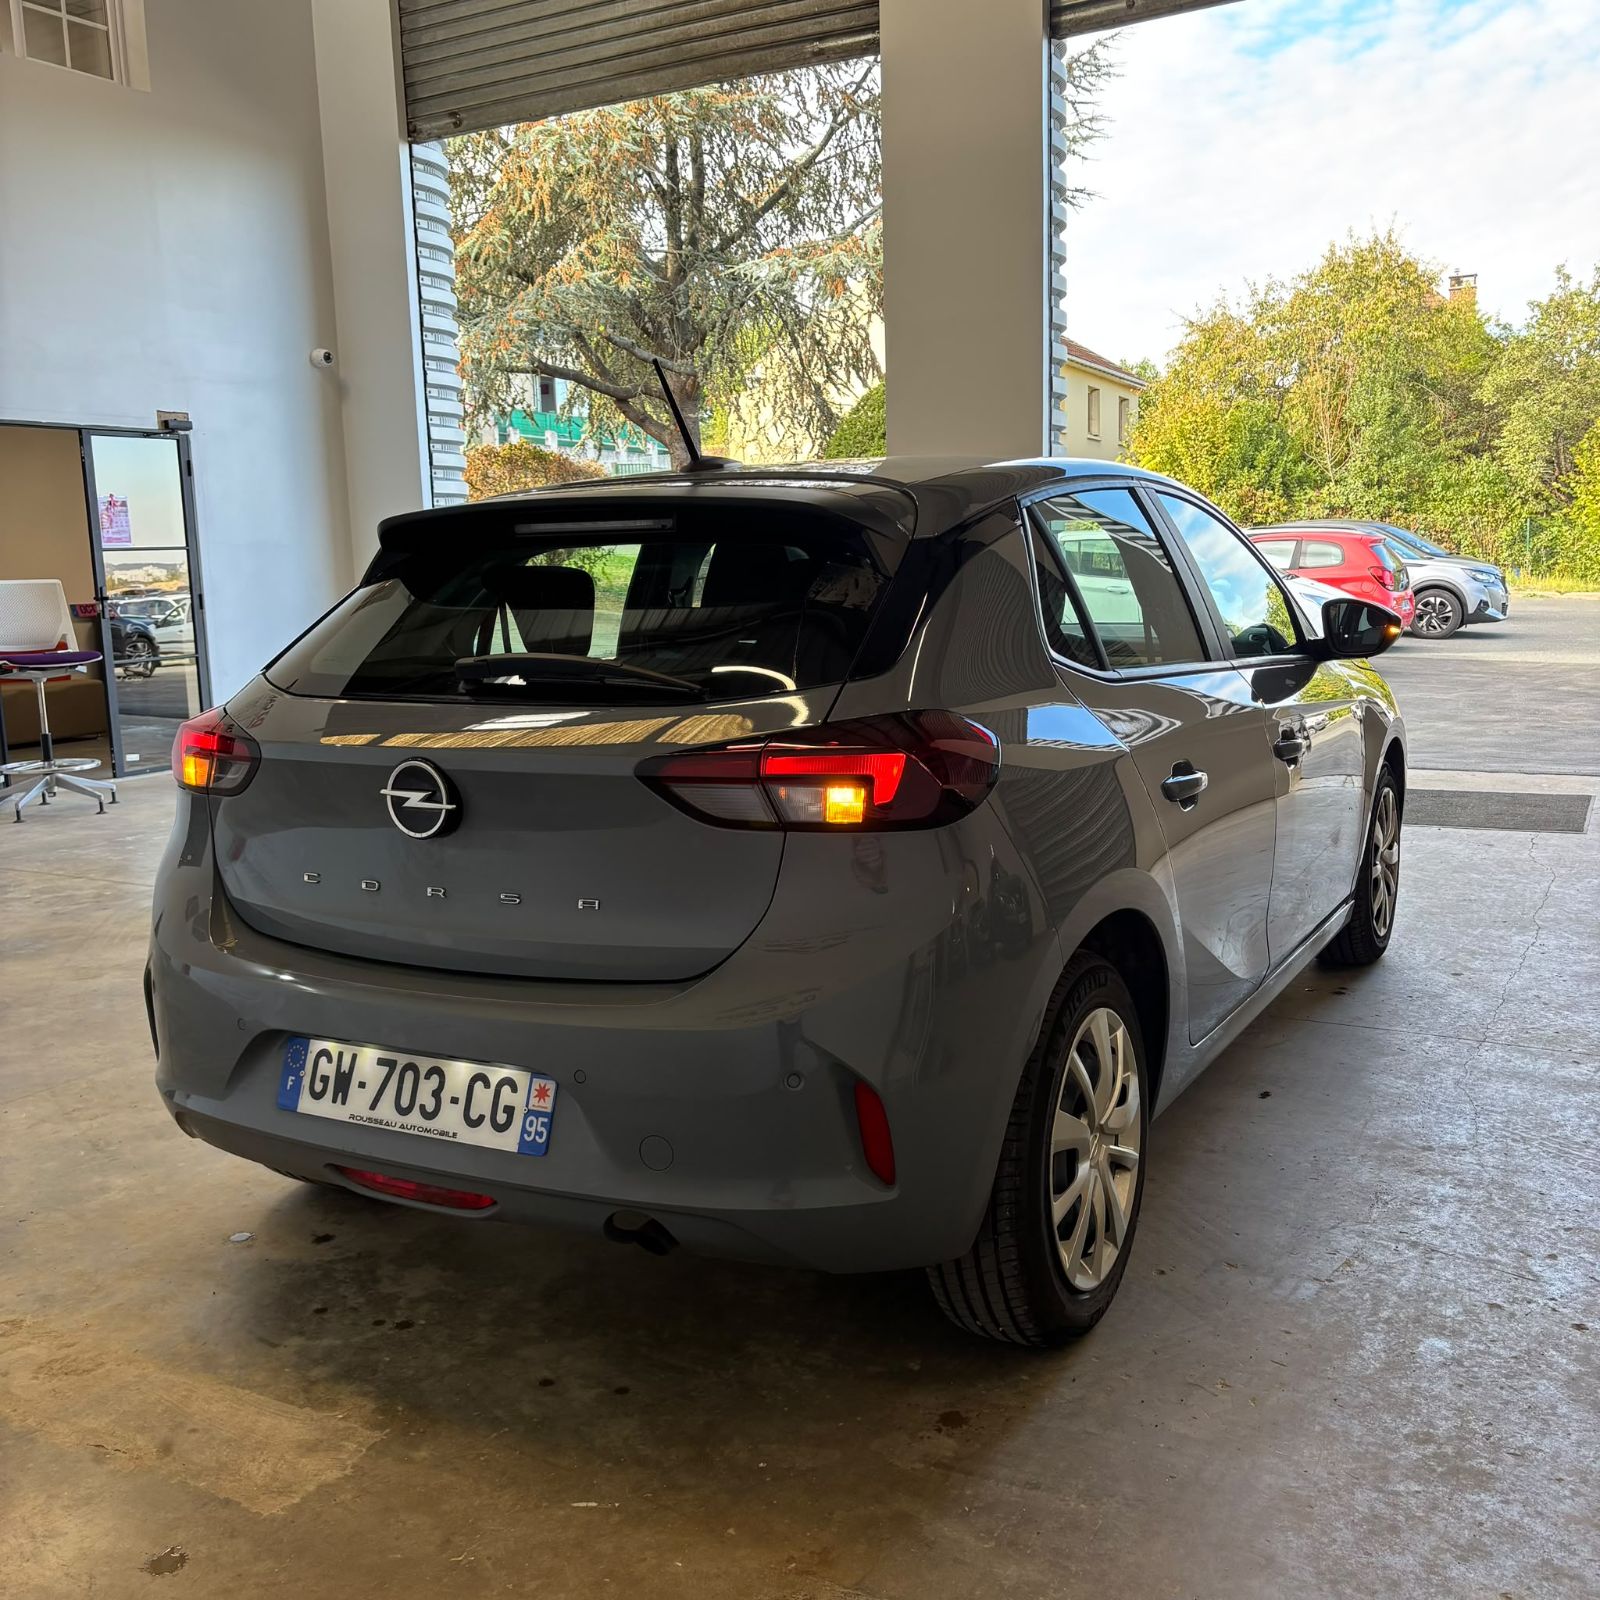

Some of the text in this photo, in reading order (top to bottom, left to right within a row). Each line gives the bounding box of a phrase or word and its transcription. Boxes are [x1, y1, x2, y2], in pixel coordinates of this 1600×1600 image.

[303, 872, 600, 910] CORSA
[285, 1075, 296, 1091] F
[308, 1048, 519, 1133] GW-703-CG
[348, 1113, 458, 1139] ROUSSEAU AUTOMOBILE
[523, 1115, 549, 1143] 95
